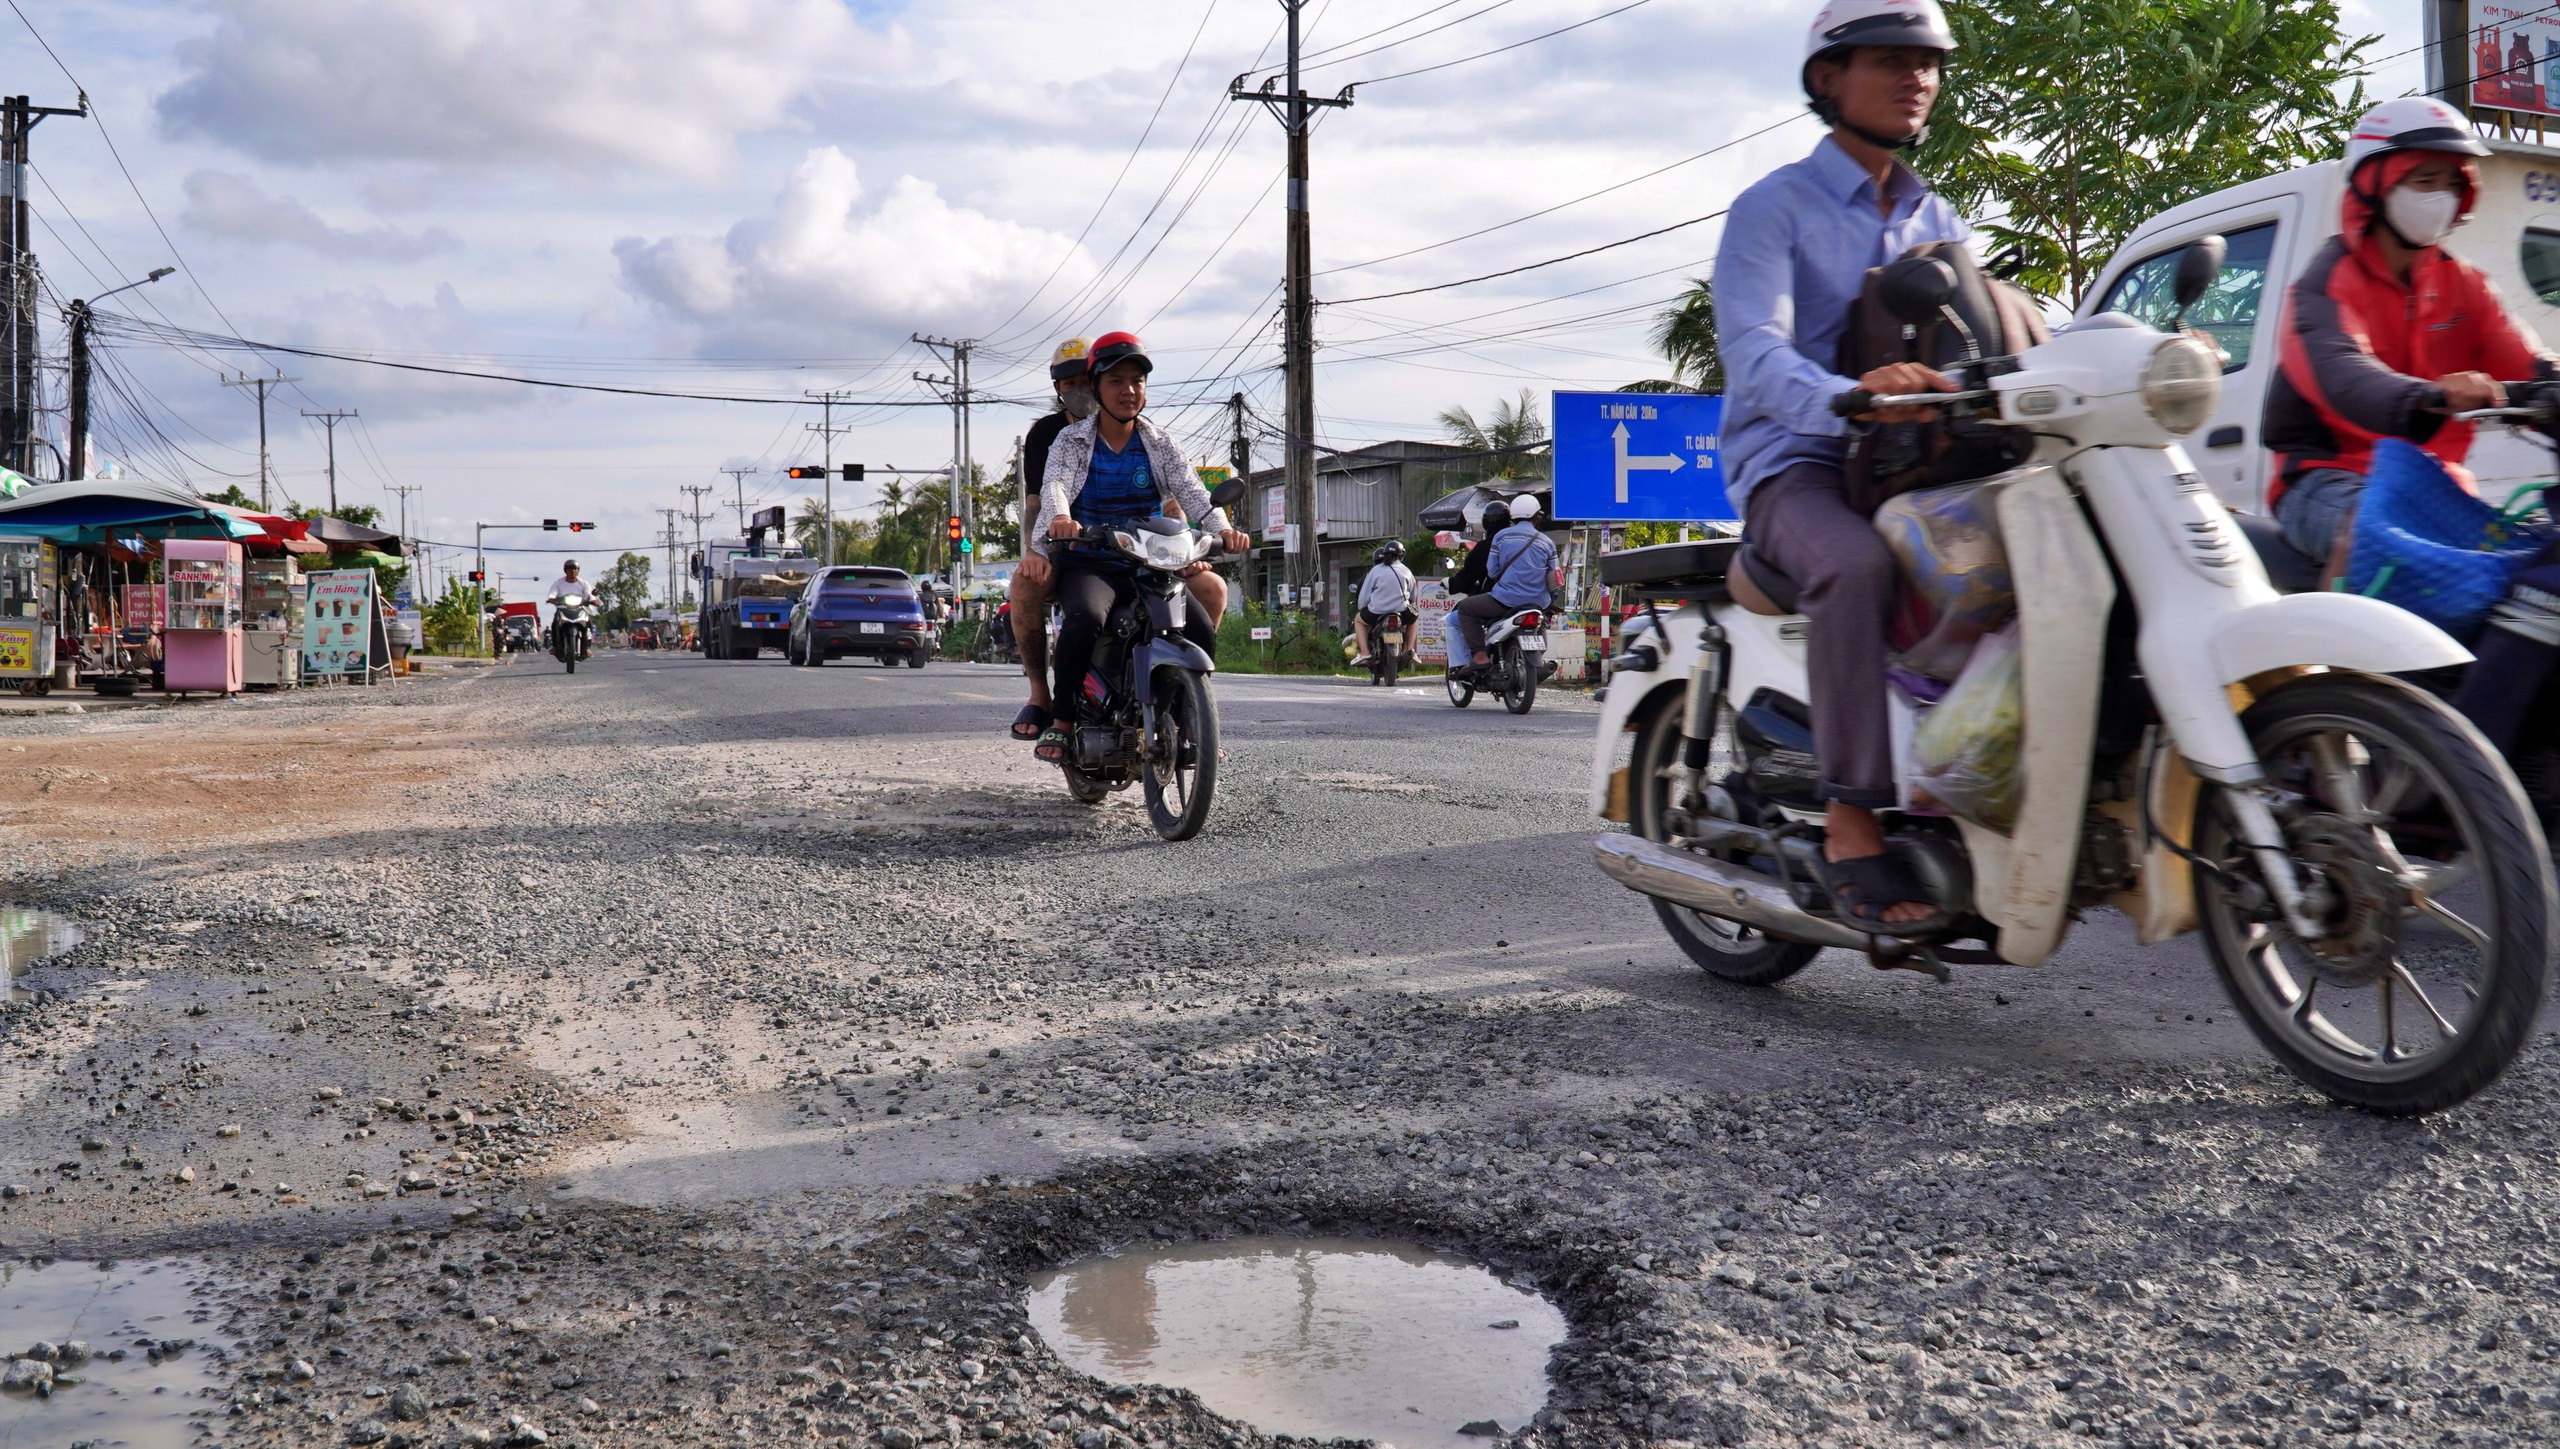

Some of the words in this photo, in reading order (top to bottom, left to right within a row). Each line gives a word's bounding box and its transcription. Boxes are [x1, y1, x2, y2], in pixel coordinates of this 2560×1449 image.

[2483, 5, 2499, 17] KIM
[1601, 404, 1609, 420] TT.
[1641, 405, 1658, 420] 20Km
[1685, 435, 1694, 450] TT.
[1696, 454, 1713, 469] 25Km
